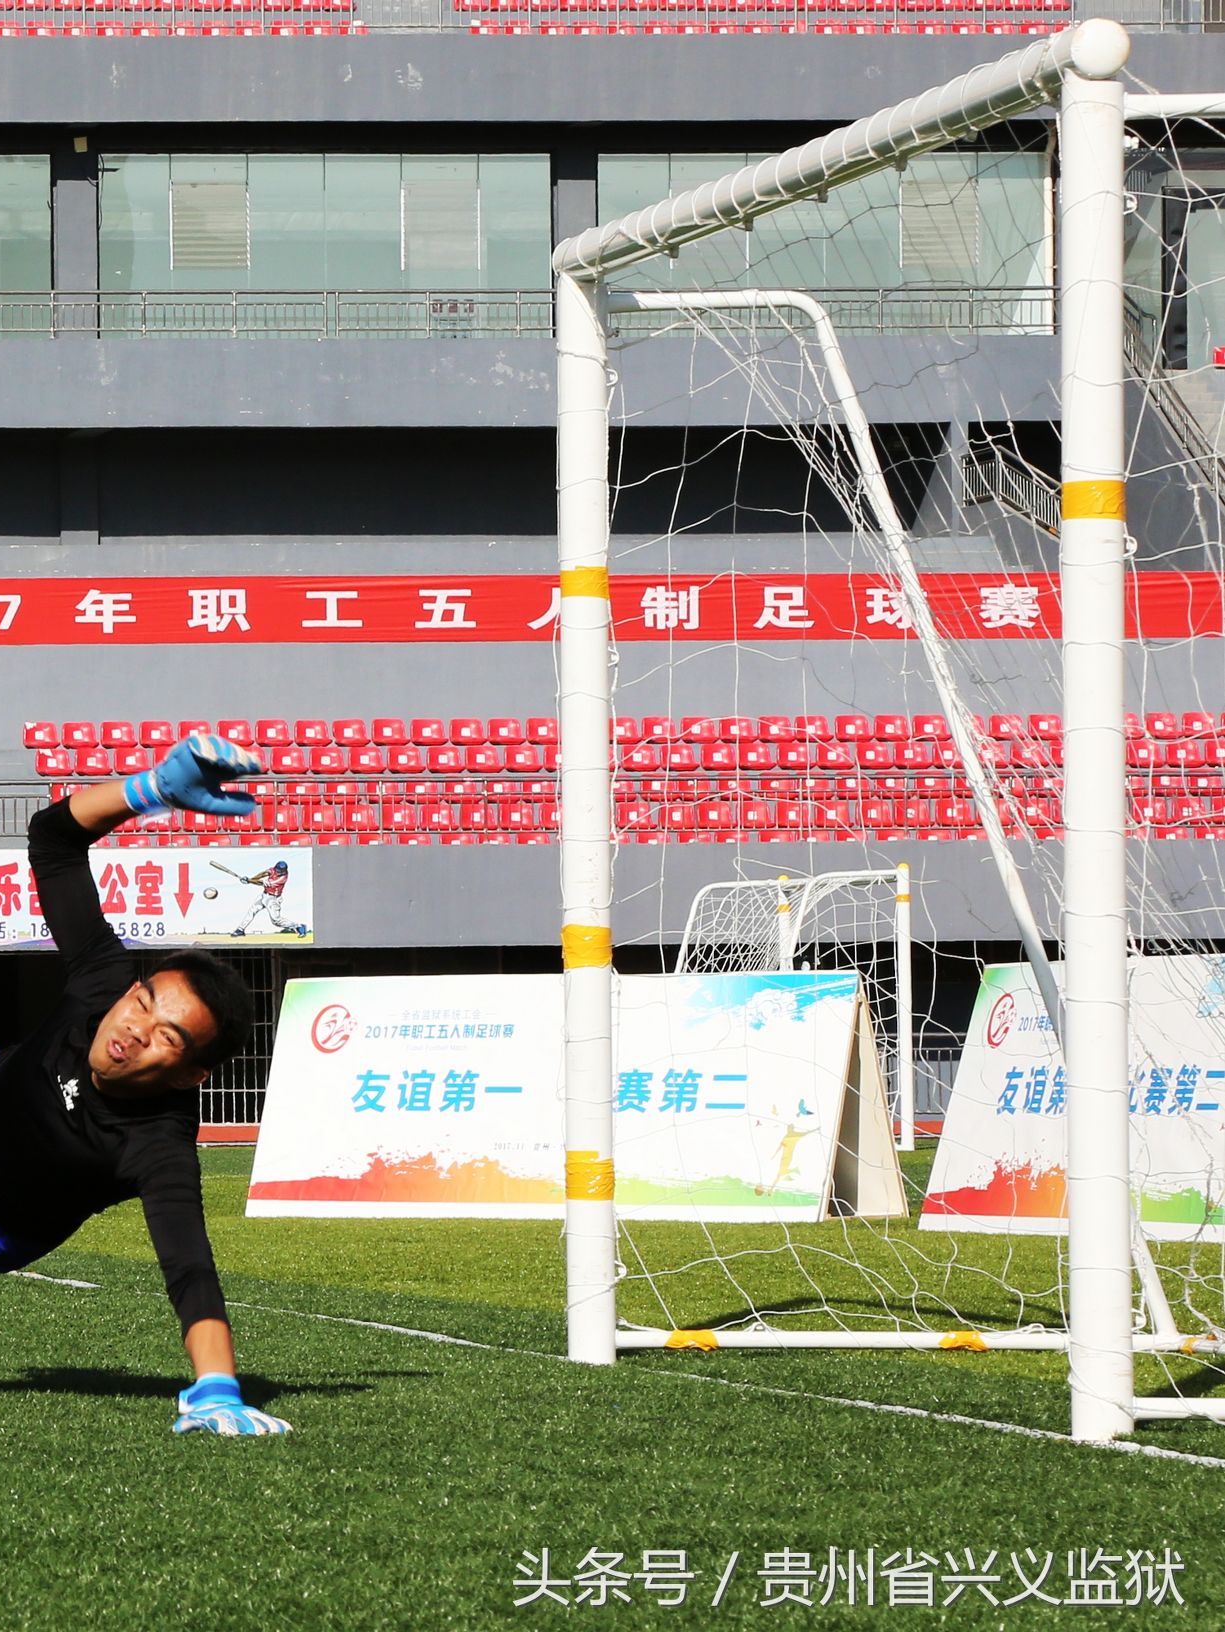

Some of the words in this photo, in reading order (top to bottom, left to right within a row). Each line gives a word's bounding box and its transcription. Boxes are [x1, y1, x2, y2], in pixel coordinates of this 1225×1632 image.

[30, 922, 166, 938] 185828
[364, 1023, 515, 1040] 2017年职工五人制足球赛
[351, 1069, 524, 1114] 友谊第一
